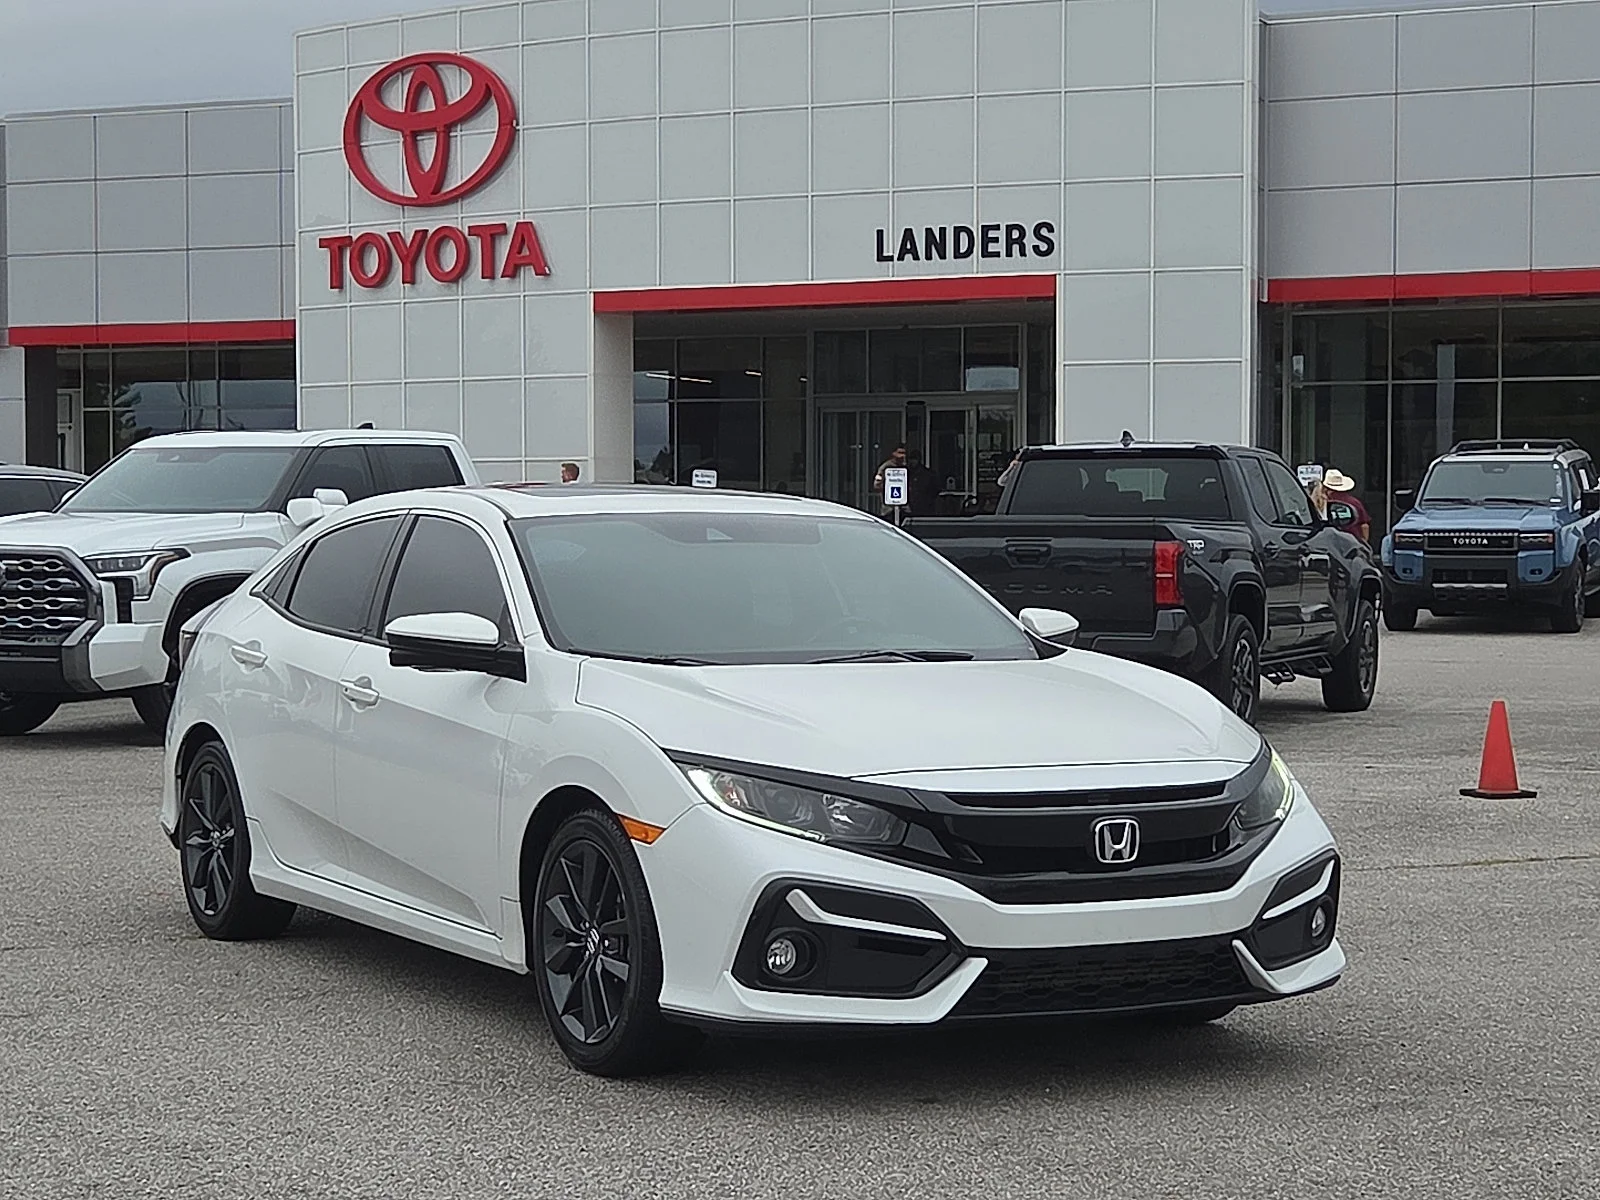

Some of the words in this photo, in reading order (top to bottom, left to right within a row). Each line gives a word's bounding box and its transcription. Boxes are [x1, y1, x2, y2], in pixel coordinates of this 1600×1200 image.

[319, 221, 551, 289] TOYOTA
[876, 221, 1055, 262] LANDERS
[1452, 537, 1488, 545] TOYOTA
